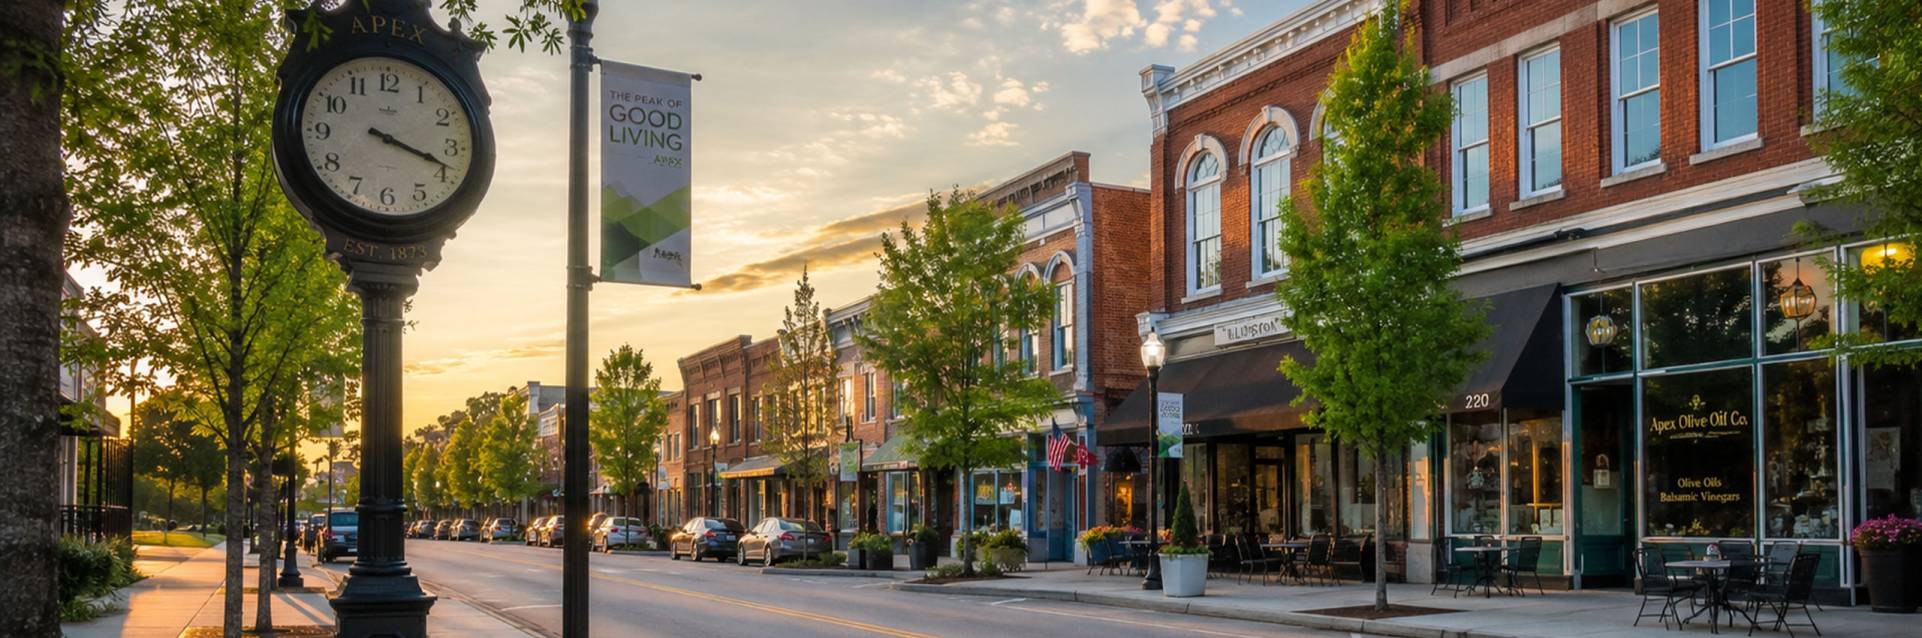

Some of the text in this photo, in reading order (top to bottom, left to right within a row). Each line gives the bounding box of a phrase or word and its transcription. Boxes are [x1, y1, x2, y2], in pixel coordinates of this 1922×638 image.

[352, 16, 426, 44] APEX
[349, 77, 367, 96] 11
[379, 73, 399, 93] 12
[326, 95, 346, 114] 10
[416, 86, 424, 104] 1
[610, 90, 682, 108] THE PEAK OF
[436, 108, 450, 127] 2
[609, 104, 682, 130] GOOD
[315, 122, 330, 140] 9
[609, 125, 682, 151] LIVING
[444, 138, 458, 156] 3
[325, 153, 339, 171] 8
[433, 164, 448, 183] 4
[348, 176, 362, 195] 7
[412, 183, 426, 202] 5
[380, 187, 395, 206] 6
[343, 238, 382, 260] EST.
[1465, 393, 1489, 409] 220
[1650, 417, 1676, 435] Apex
[1678, 414, 1708, 429] Olive
[1709, 410, 1728, 427] Oil
[1730, 410, 1748, 426] Co.
[1677, 476, 1722, 488] Olive Oils
[1660, 492, 1740, 504] Balsamic Vinegars
